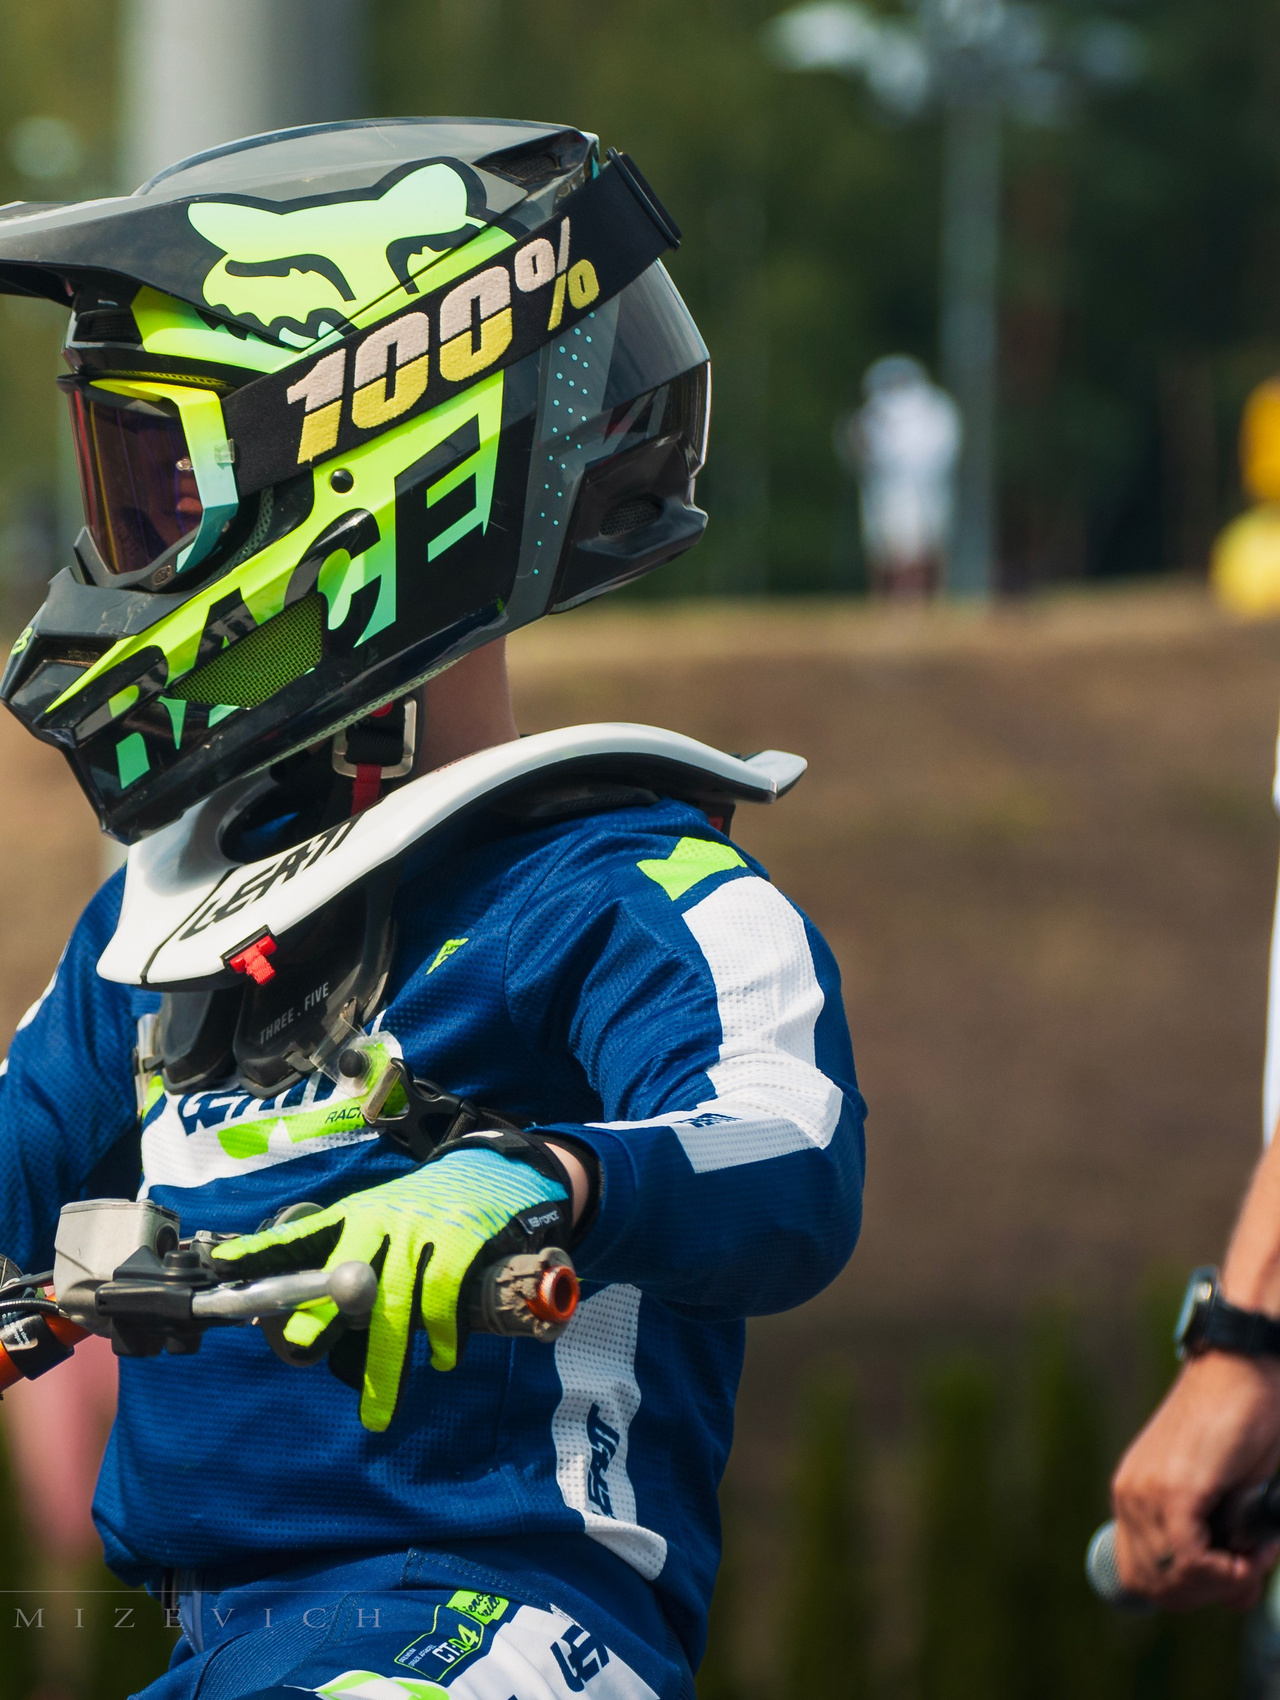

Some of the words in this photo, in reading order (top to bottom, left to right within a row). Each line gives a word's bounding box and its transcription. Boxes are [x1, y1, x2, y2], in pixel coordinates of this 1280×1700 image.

[286, 216, 600, 465] 100%
[260, 1007, 294, 1044] THREE
[304, 982, 329, 1011] FIVE
